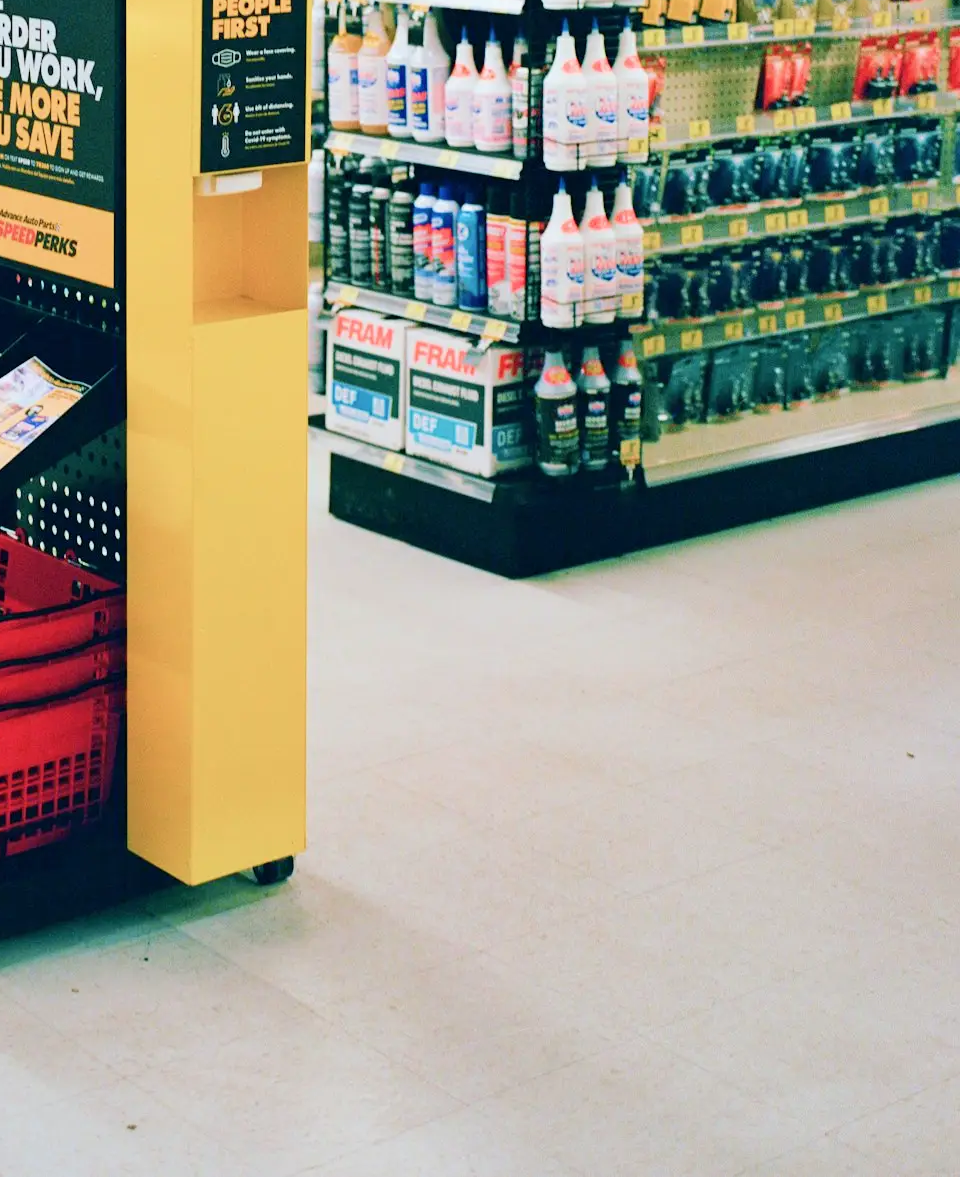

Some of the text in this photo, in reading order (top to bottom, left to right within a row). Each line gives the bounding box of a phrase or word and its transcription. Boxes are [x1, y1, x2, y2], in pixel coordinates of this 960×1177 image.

[212, 14, 271, 41] FIRST
[16, 49, 104, 101] WORK,
[9, 81, 81, 127] MORE
[15, 117, 74, 161] SAVE
[23, 215, 38, 226] Auto
[38, 218, 55, 231] Parts
[336, 315, 394, 350] FRAM
